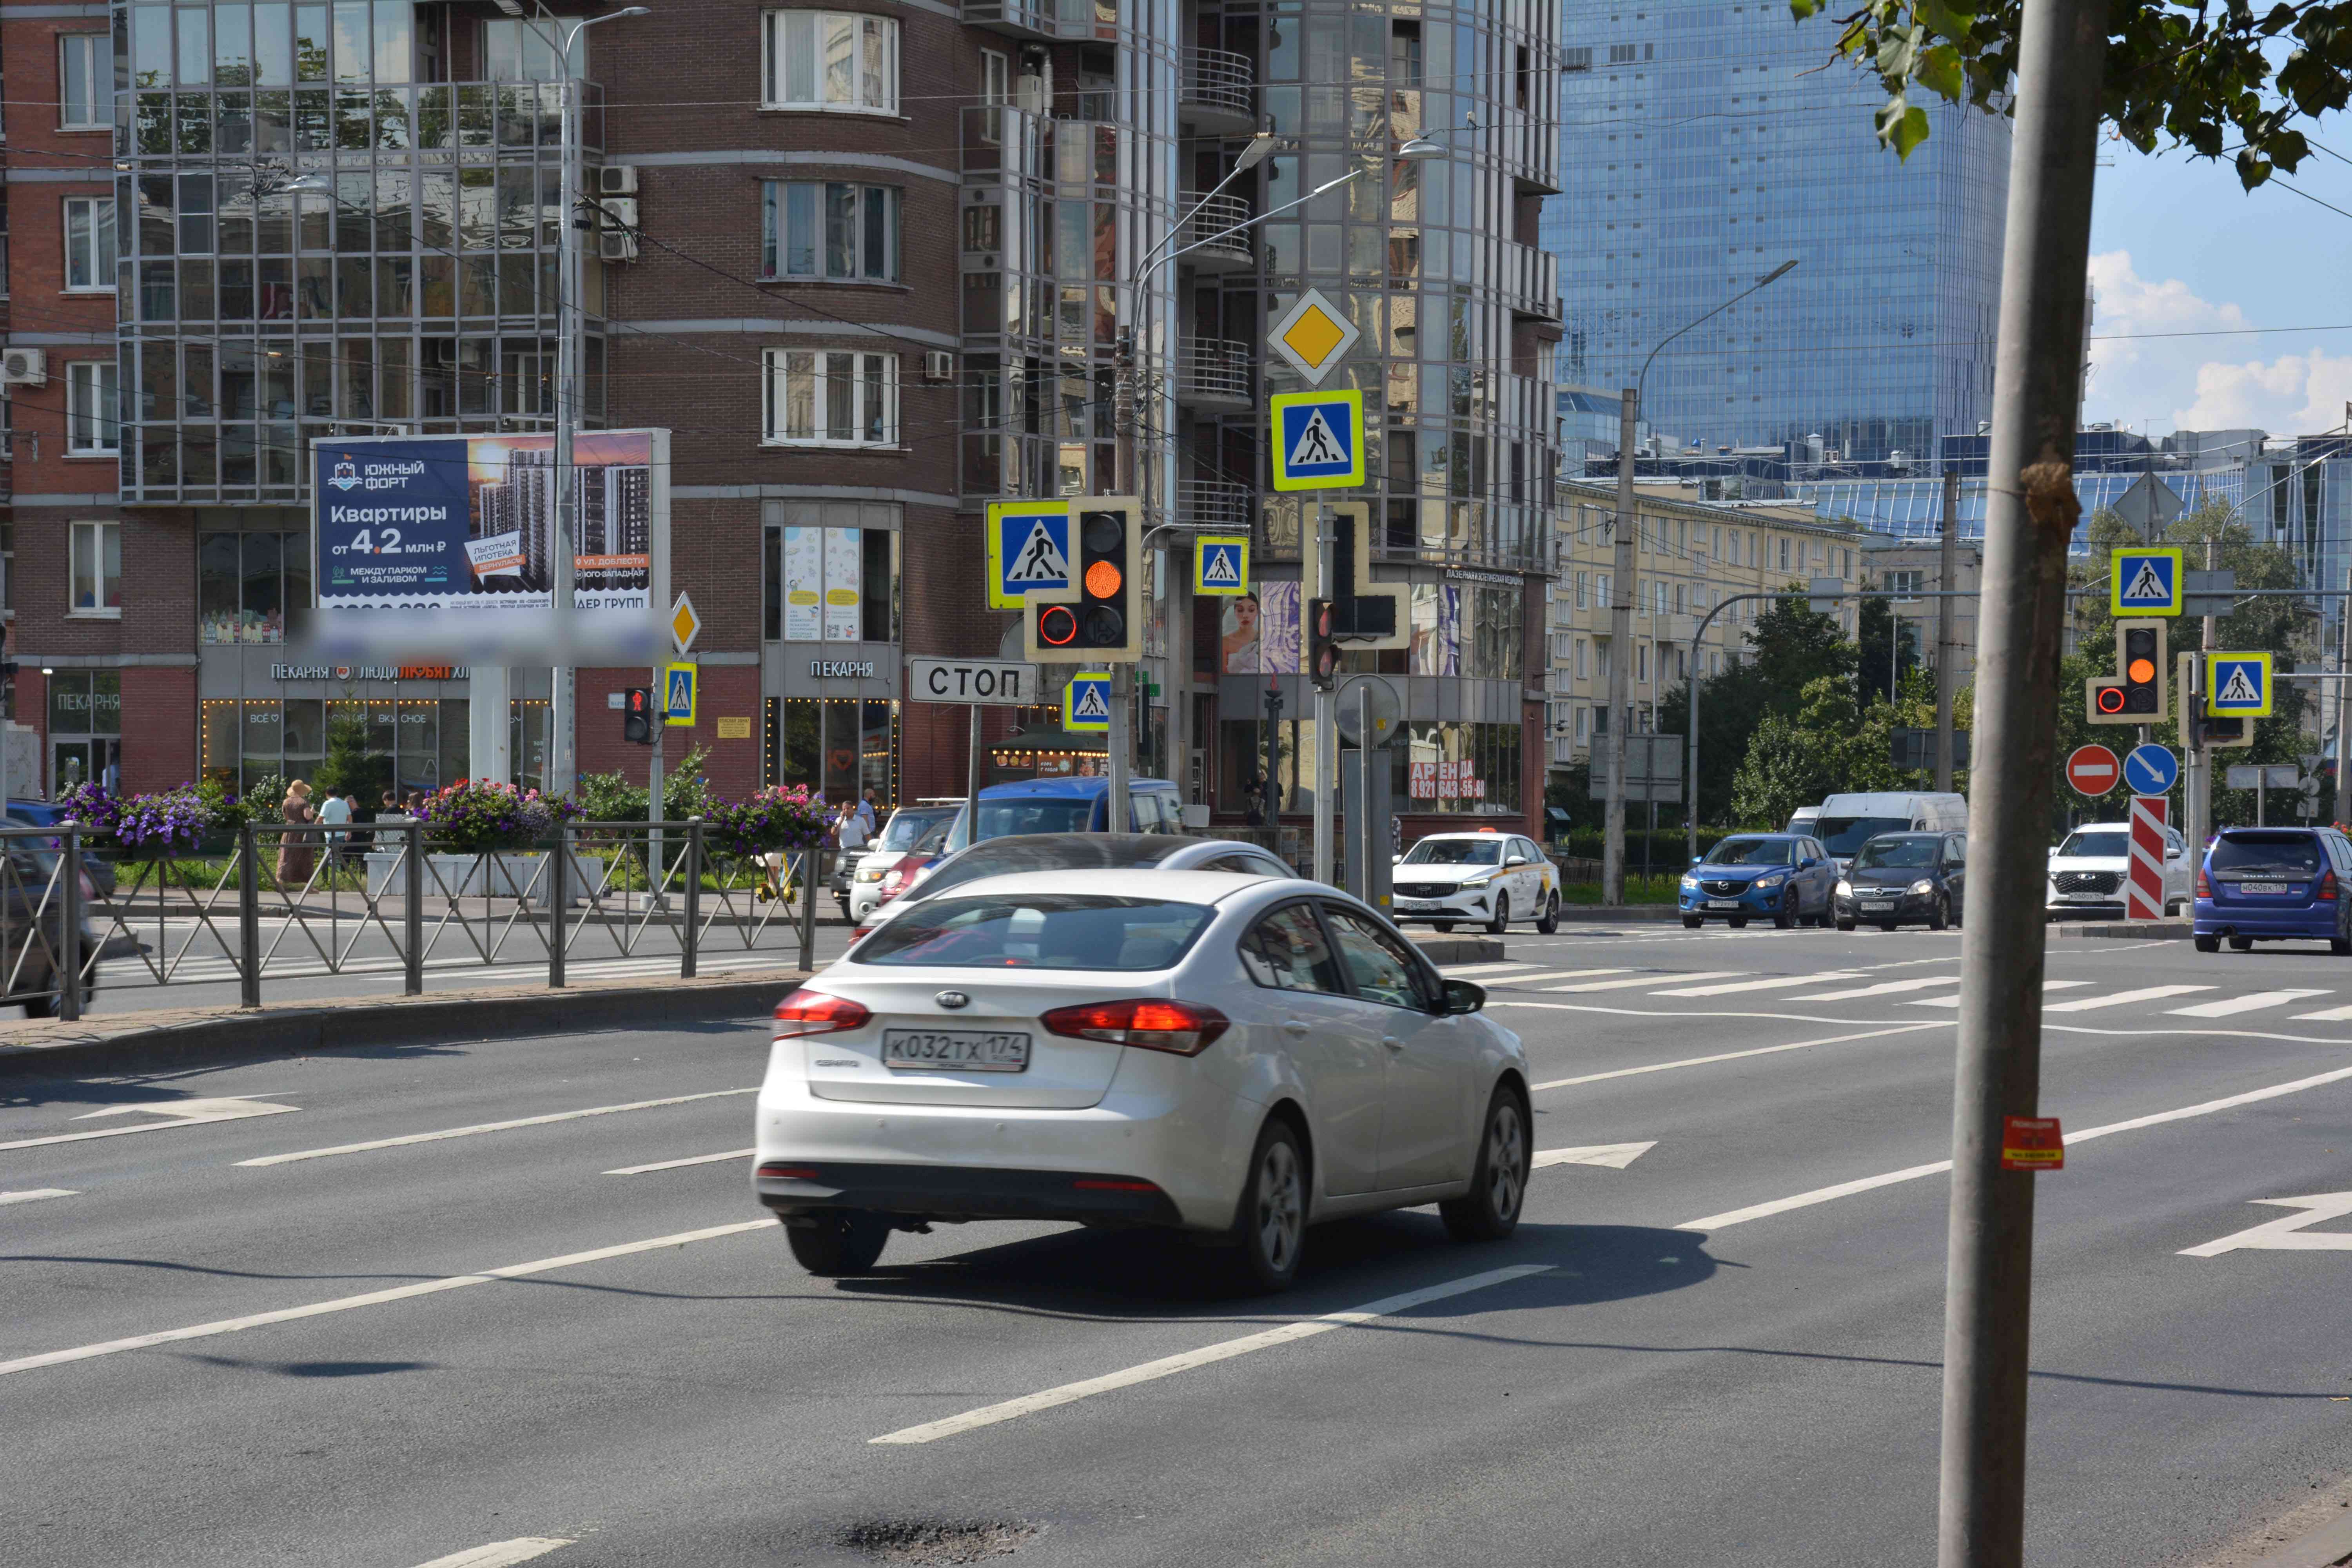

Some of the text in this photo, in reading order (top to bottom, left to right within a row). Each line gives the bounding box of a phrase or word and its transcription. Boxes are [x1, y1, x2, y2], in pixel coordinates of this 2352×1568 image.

[365, 461, 424, 475] ЮЖНЫЙ
[365, 477, 408, 490] ФОРТ
[331, 506, 446, 524] Квартиры
[332, 546, 348, 555] от
[351, 528, 401, 554] 4.2
[405, 544, 434, 553] млн
[474, 540, 517, 554] ЛЬГОТНАЯ
[475, 549, 514, 562] ИПОТЕКА
[479, 557, 523, 571] ВЕРНУЛАСЬ!
[1446, 569, 1474, 580] ЛАЗЕРНАЯ
[271, 664, 329, 679] ПЕКАРНЯ
[359, 667, 398, 680] ЛЮДИ
[811, 661, 873, 677] ПЕКАРНЯ
[929, 667, 1019, 697] СТОП
[58, 694, 120, 710] ПЕКАРНЯ
[250, 713, 269, 723] ВСЁ
[1412, 760, 1474, 780] АРЕНДА
[1412, 780, 1417, 797] 8
[1419, 780, 1435, 797] 921
[891, 1035, 1022, 1060] К032ТХ 174
